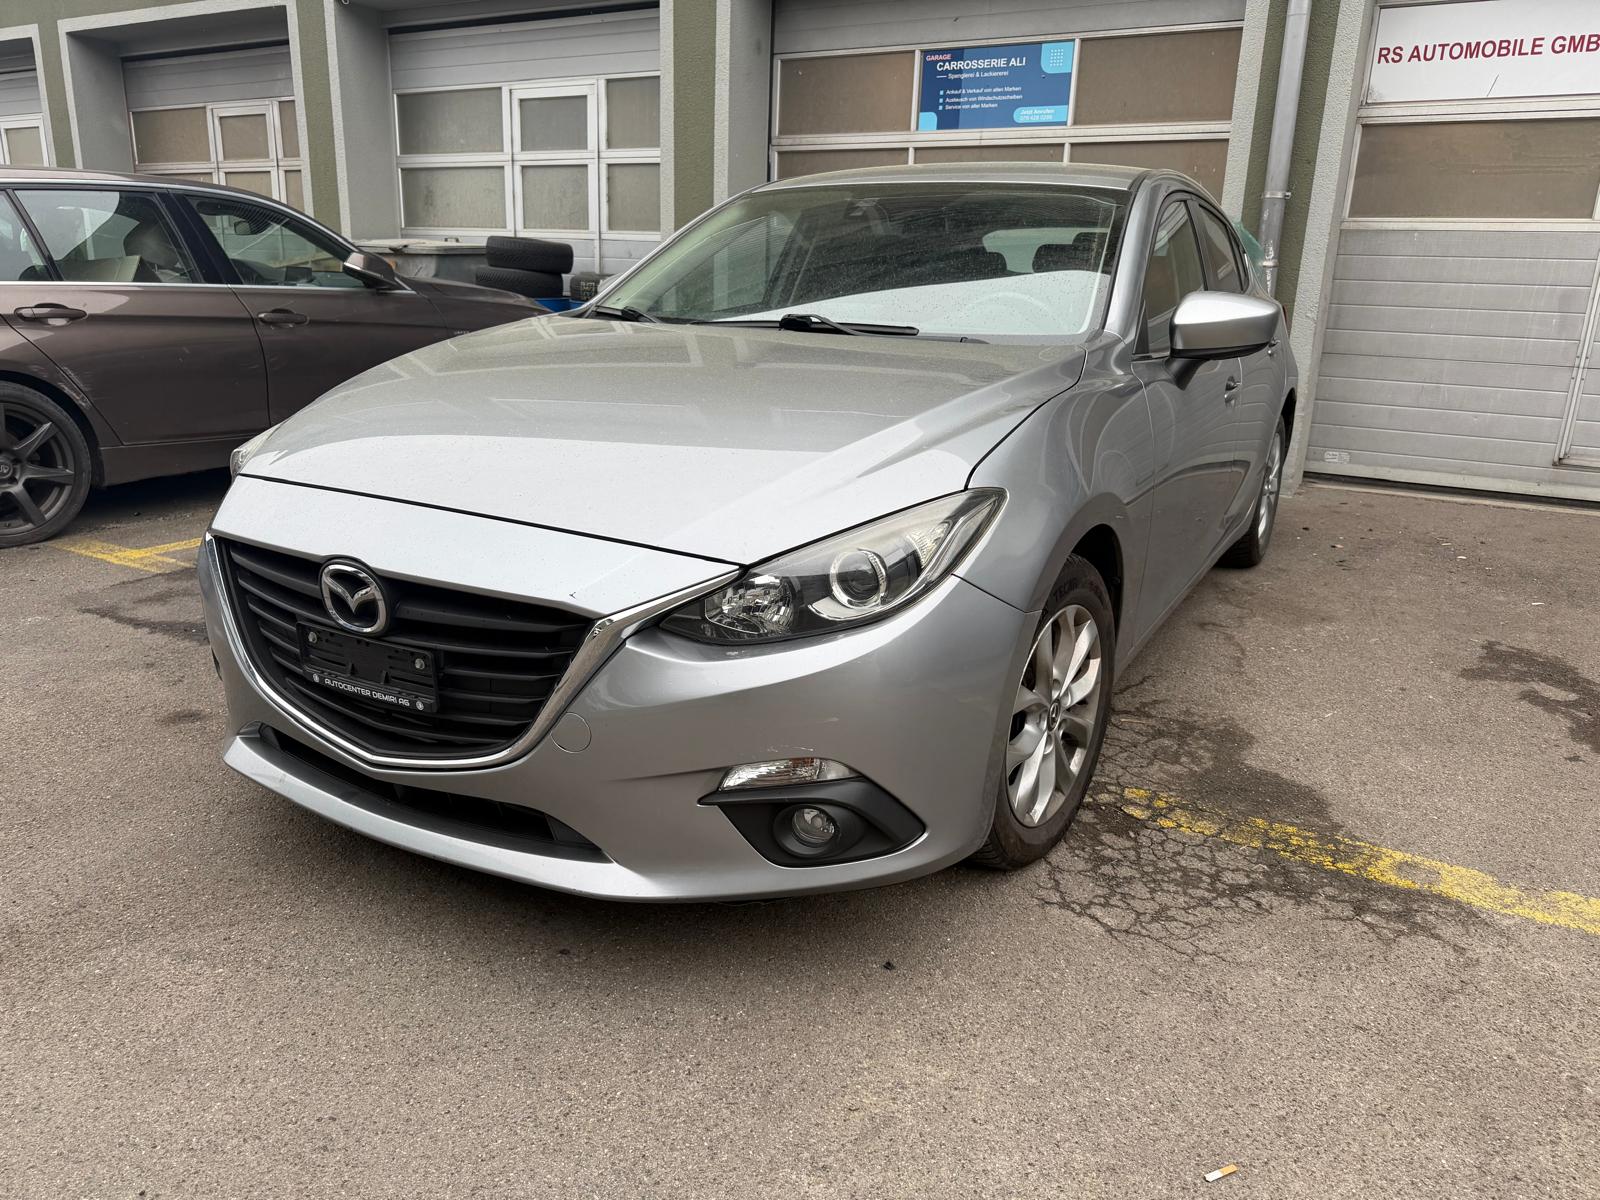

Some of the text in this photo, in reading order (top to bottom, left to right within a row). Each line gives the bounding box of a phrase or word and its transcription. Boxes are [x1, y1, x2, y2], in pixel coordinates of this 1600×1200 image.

[926, 53, 952, 61] GARAGE
[1377, 46, 1403, 64] RS
[1407, 37, 1545, 63] AUTOMOBILE
[936, 57, 1026, 71] CARROSSERIE ALI
[947, 71, 975, 80] Spenglerei
[324, 678, 410, 707] AUTOCENTER DEMIRI AG
